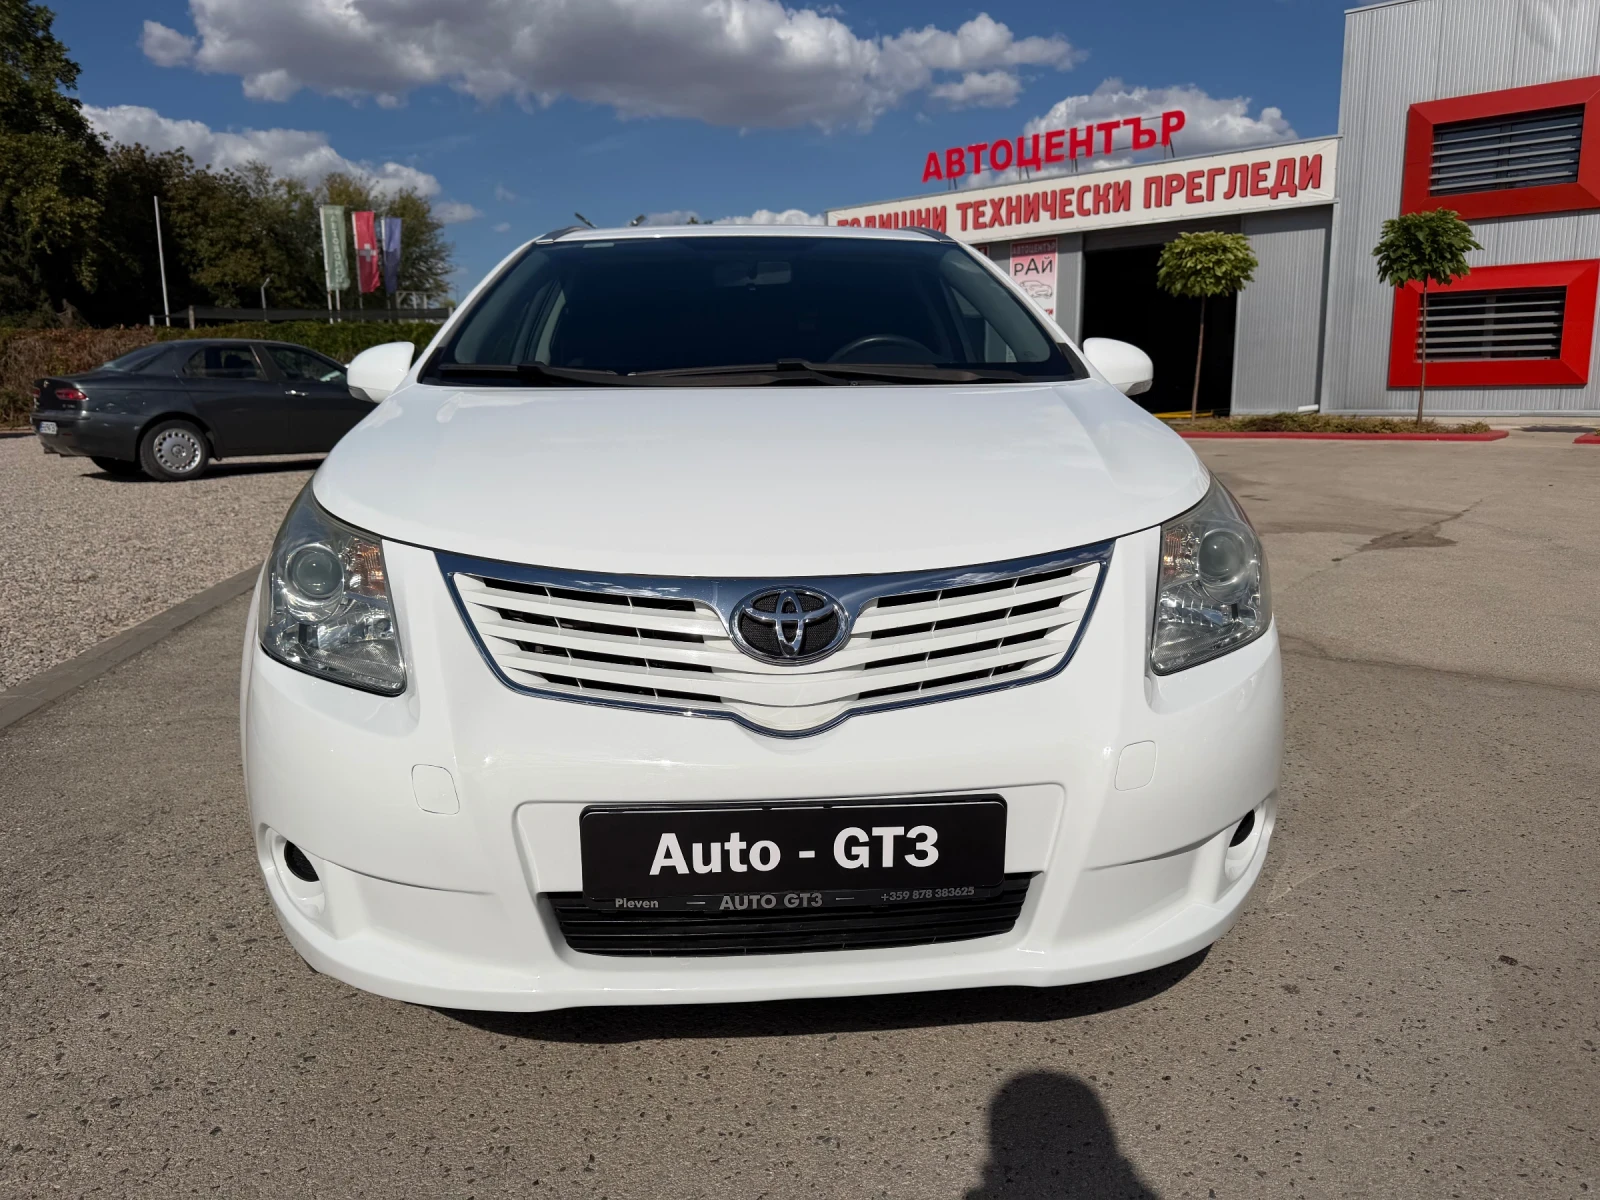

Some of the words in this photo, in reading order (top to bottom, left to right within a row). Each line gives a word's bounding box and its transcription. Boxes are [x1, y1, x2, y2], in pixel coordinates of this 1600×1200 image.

[922, 110, 1186, 183] АВТОЦЕНТЪР
[956, 180, 1132, 232] ТЕХНИЧЕСКИ
[1143, 154, 1323, 209] ПРЕГЛЕДИ
[1013, 256, 1053, 276] РАЙ
[649, 832, 781, 875] Auto
[833, 826, 939, 869] GT3
[615, 897, 659, 908] Pleven
[719, 894, 777, 910] AUTO
[783, 893, 823, 908] GT3
[881, 891, 909, 901] +359
[912, 889, 932, 899] 878
[935, 887, 975, 898] 383625
